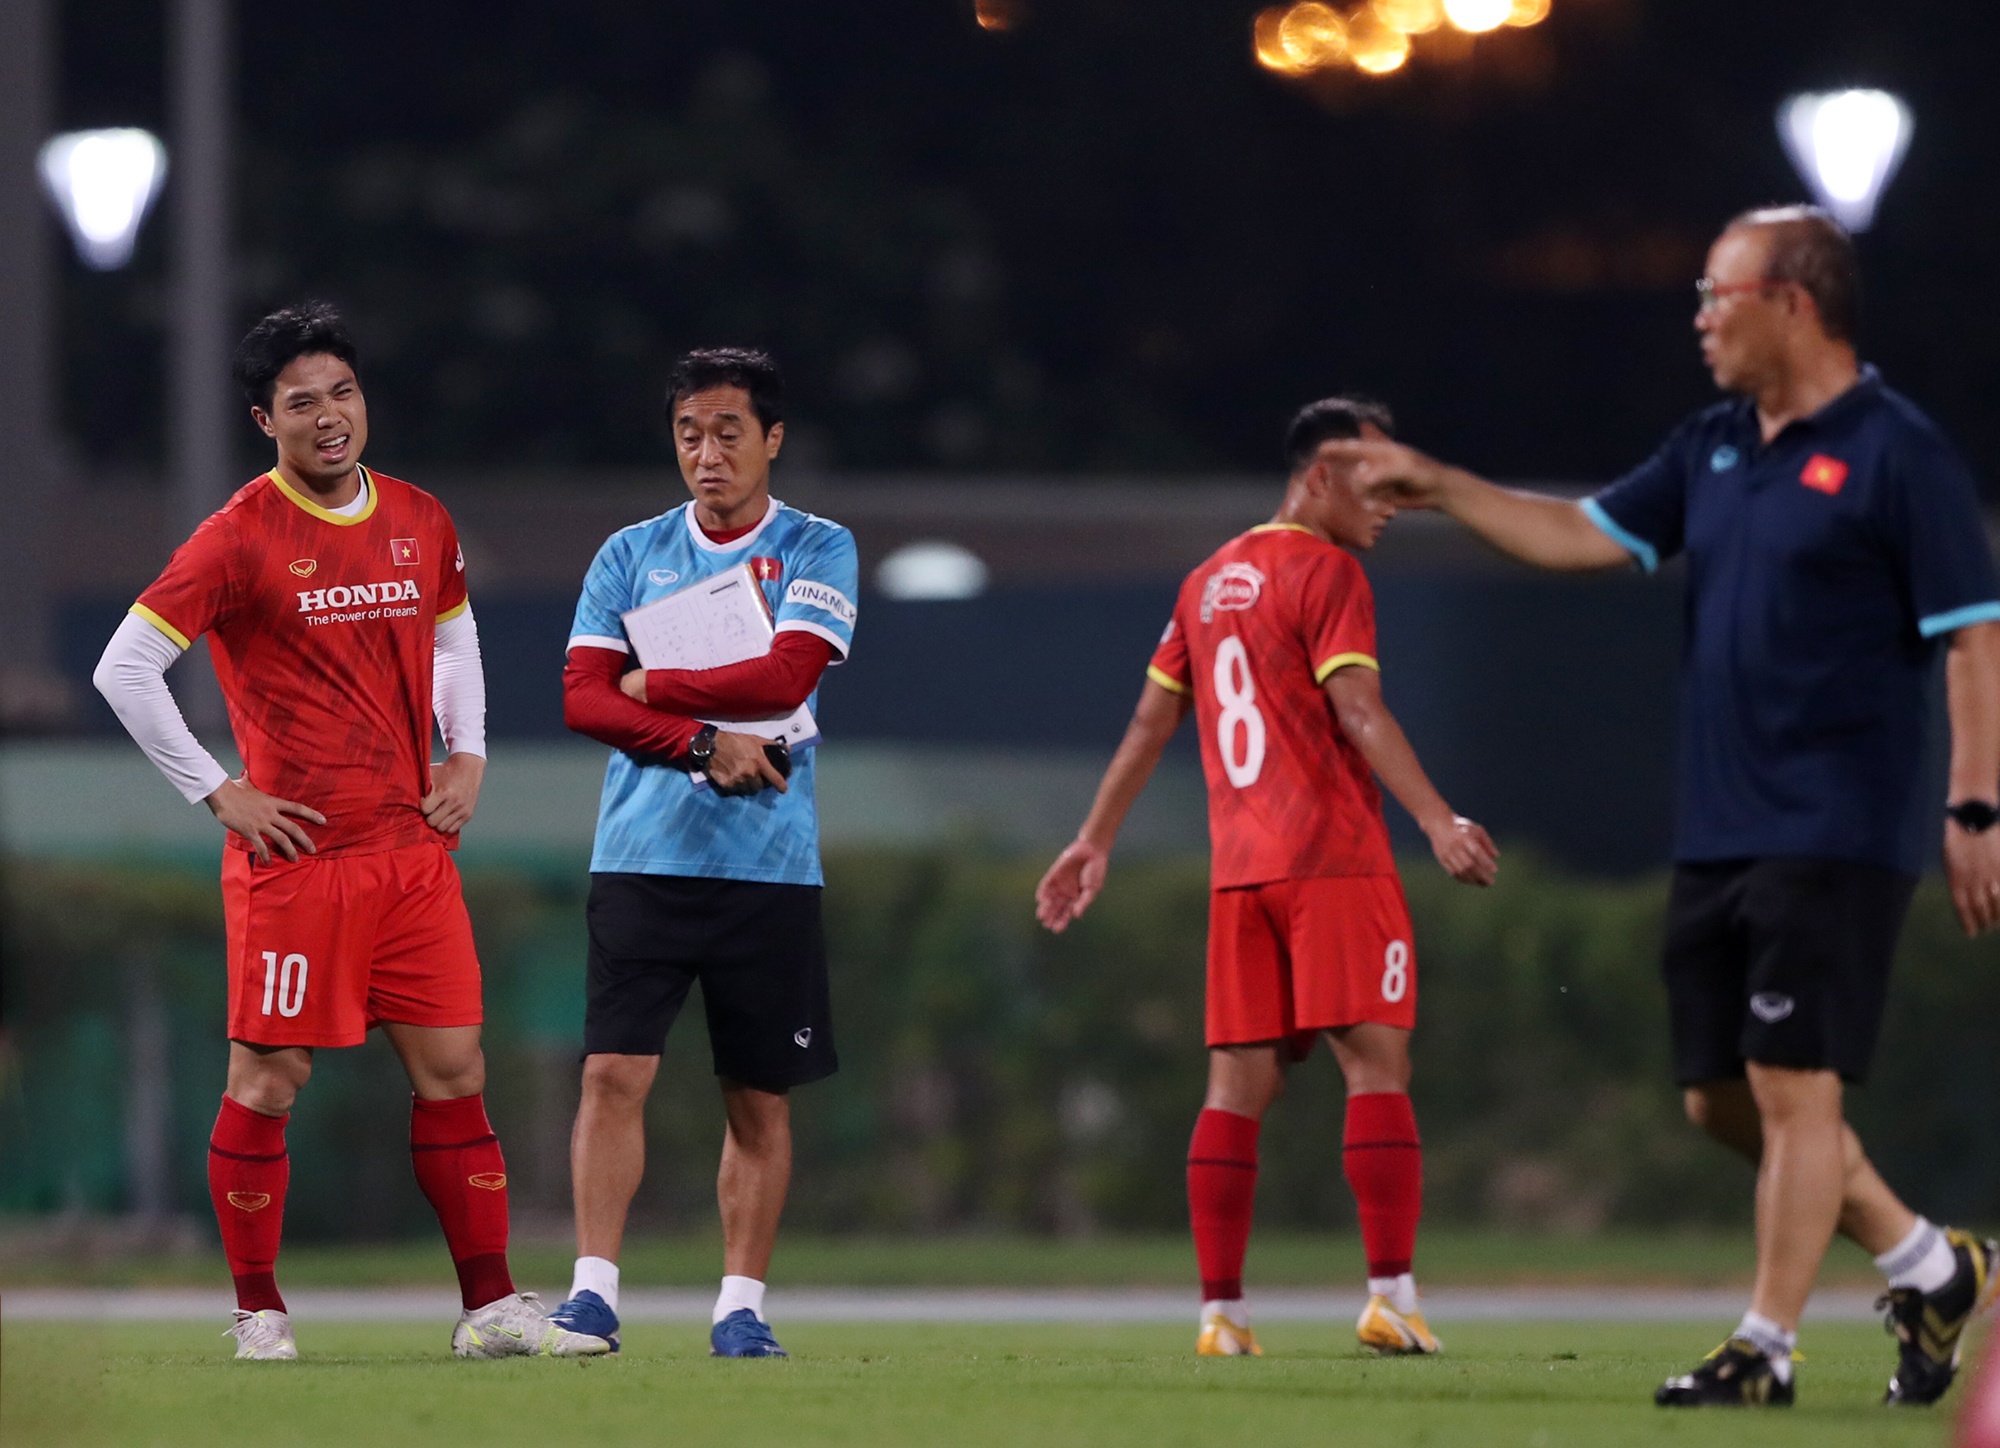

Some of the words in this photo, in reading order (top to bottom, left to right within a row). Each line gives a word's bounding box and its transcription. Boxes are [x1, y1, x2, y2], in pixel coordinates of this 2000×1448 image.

[297, 580, 420, 612] HONDA
[305, 615, 329, 627] The
[331, 609, 367, 624] Power
[368, 609, 381, 620] of
[384, 606, 418, 618] Dreams
[1214, 635, 1266, 788] 8
[262, 950, 309, 1018] 10
[1381, 939, 1408, 1003] 8
